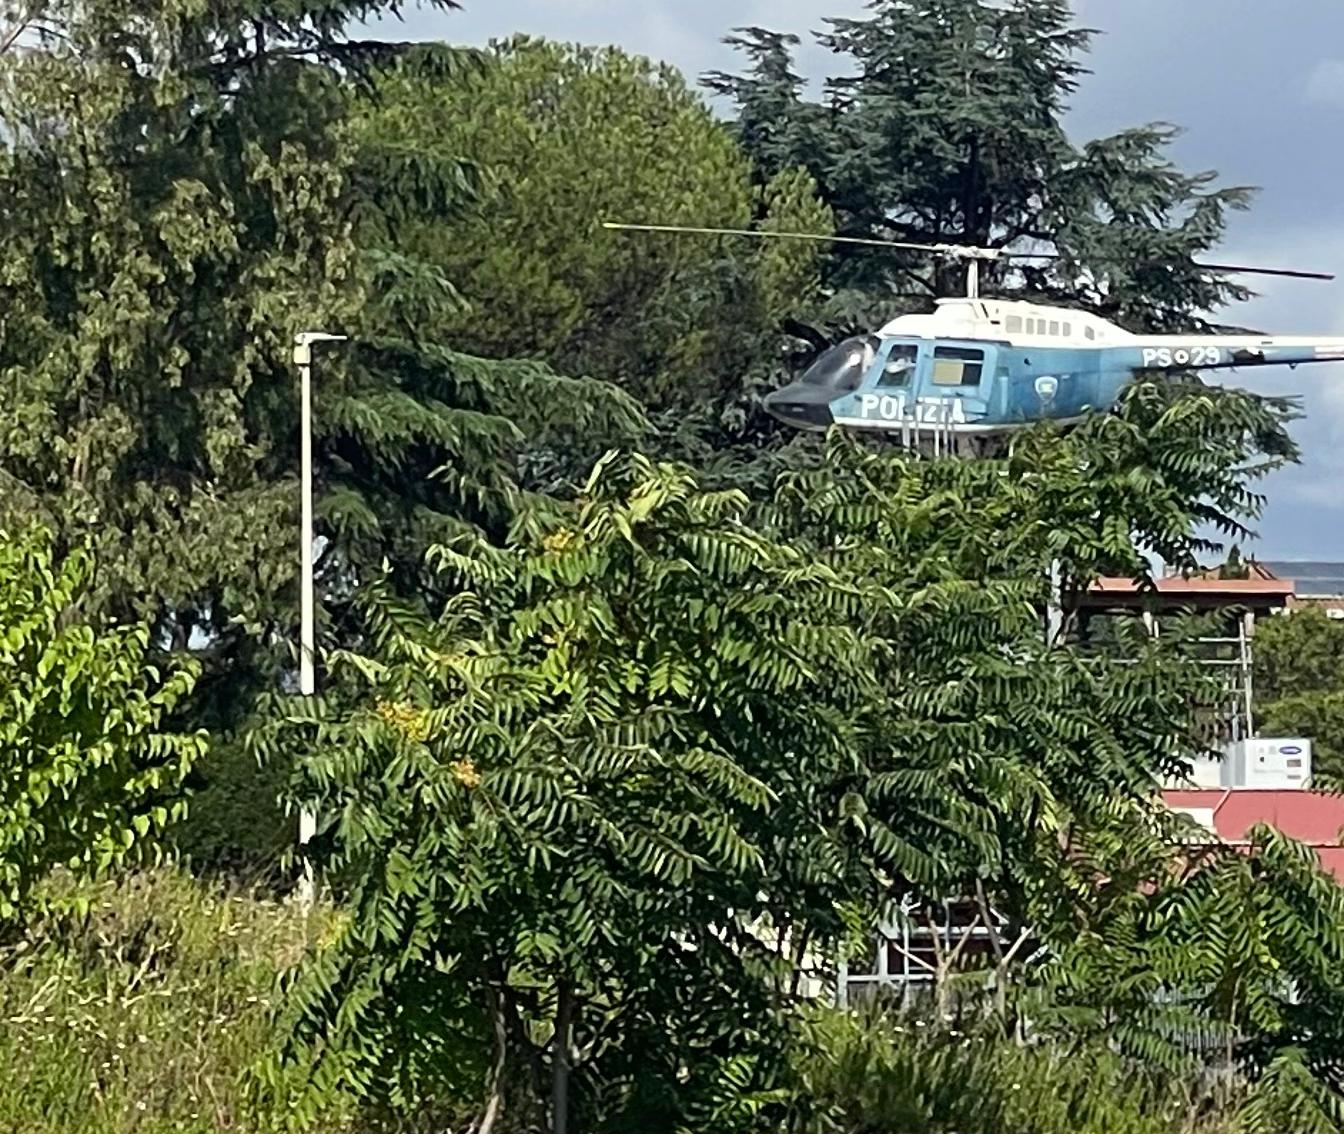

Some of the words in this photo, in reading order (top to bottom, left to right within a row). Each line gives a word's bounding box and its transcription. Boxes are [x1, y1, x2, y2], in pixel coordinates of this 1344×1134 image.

[1142, 348, 1171, 367] PS
[1190, 346, 1221, 366] 29
[861, 391, 966, 423] POLIZIA
